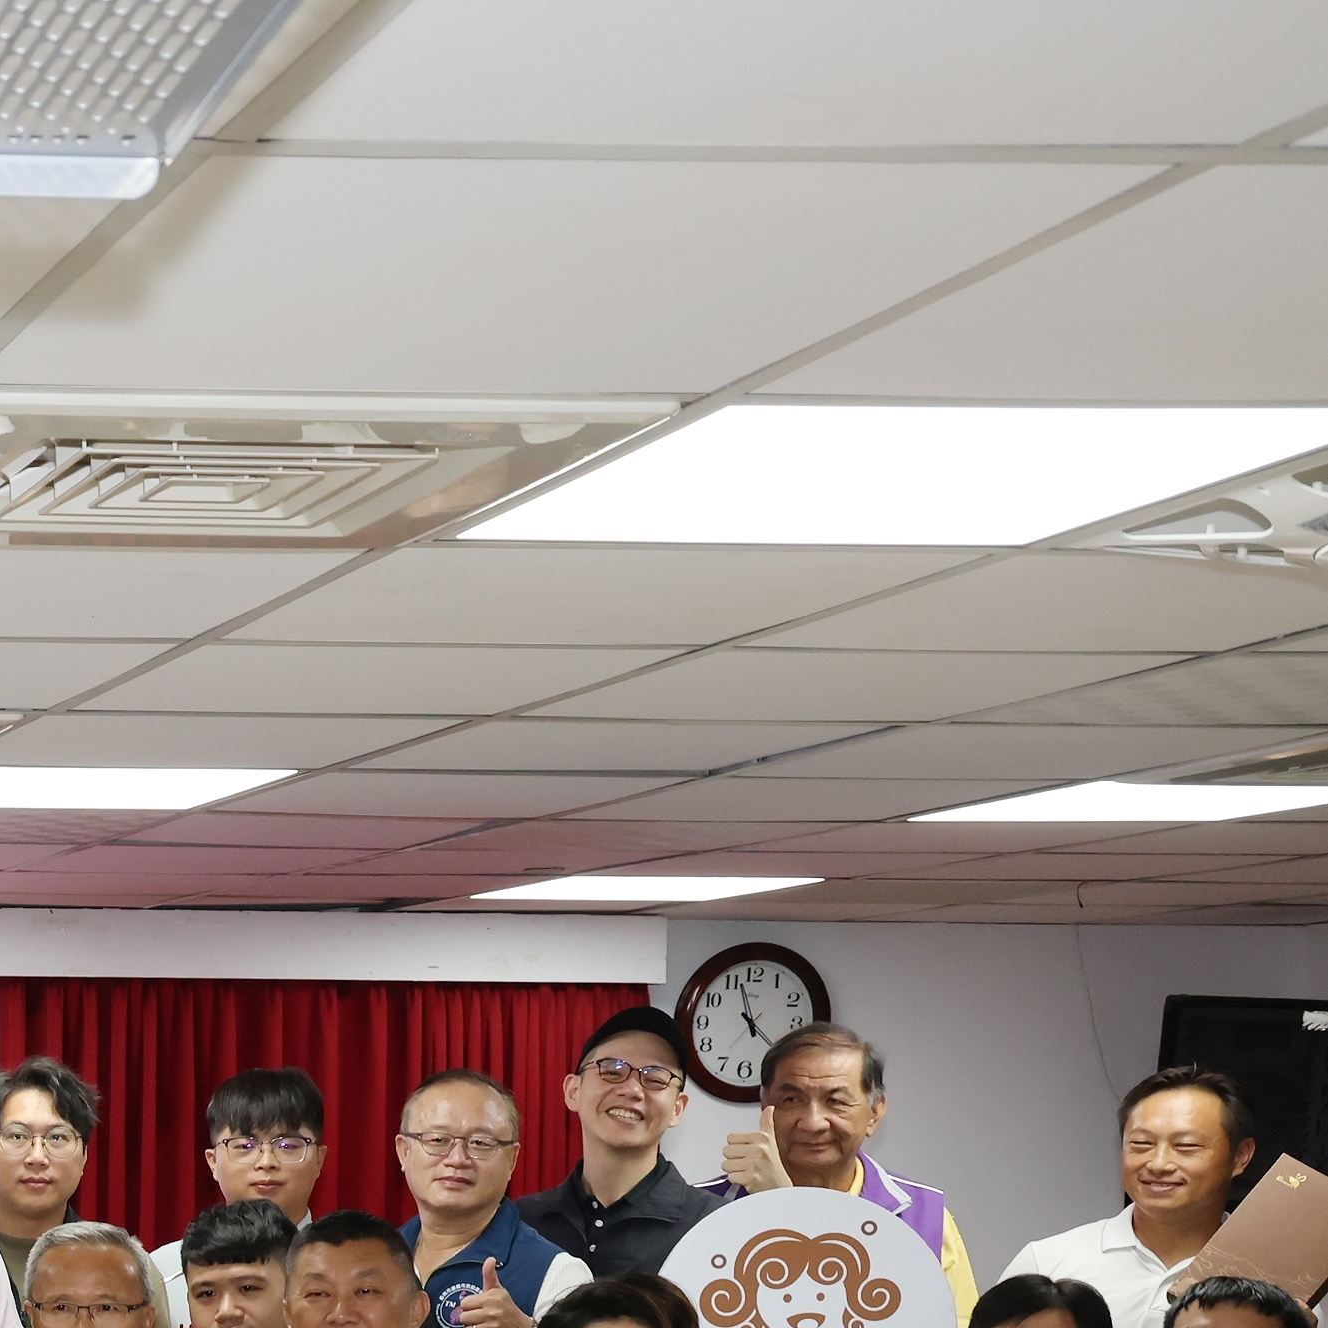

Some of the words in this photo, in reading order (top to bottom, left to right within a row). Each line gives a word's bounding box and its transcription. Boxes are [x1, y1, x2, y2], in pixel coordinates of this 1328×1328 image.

[746, 967, 764, 982] 12
[774, 973, 780, 989] 1
[725, 975, 739, 990] 11
[705, 992, 722, 1008] 10
[787, 992, 800, 1007] 2
[696, 1015, 709, 1030] 9
[790, 1016, 803, 1030] 3
[699, 1037, 712, 1052] 8
[717, 1056, 730, 1072] 7
[737, 1060, 753, 1079] 6
